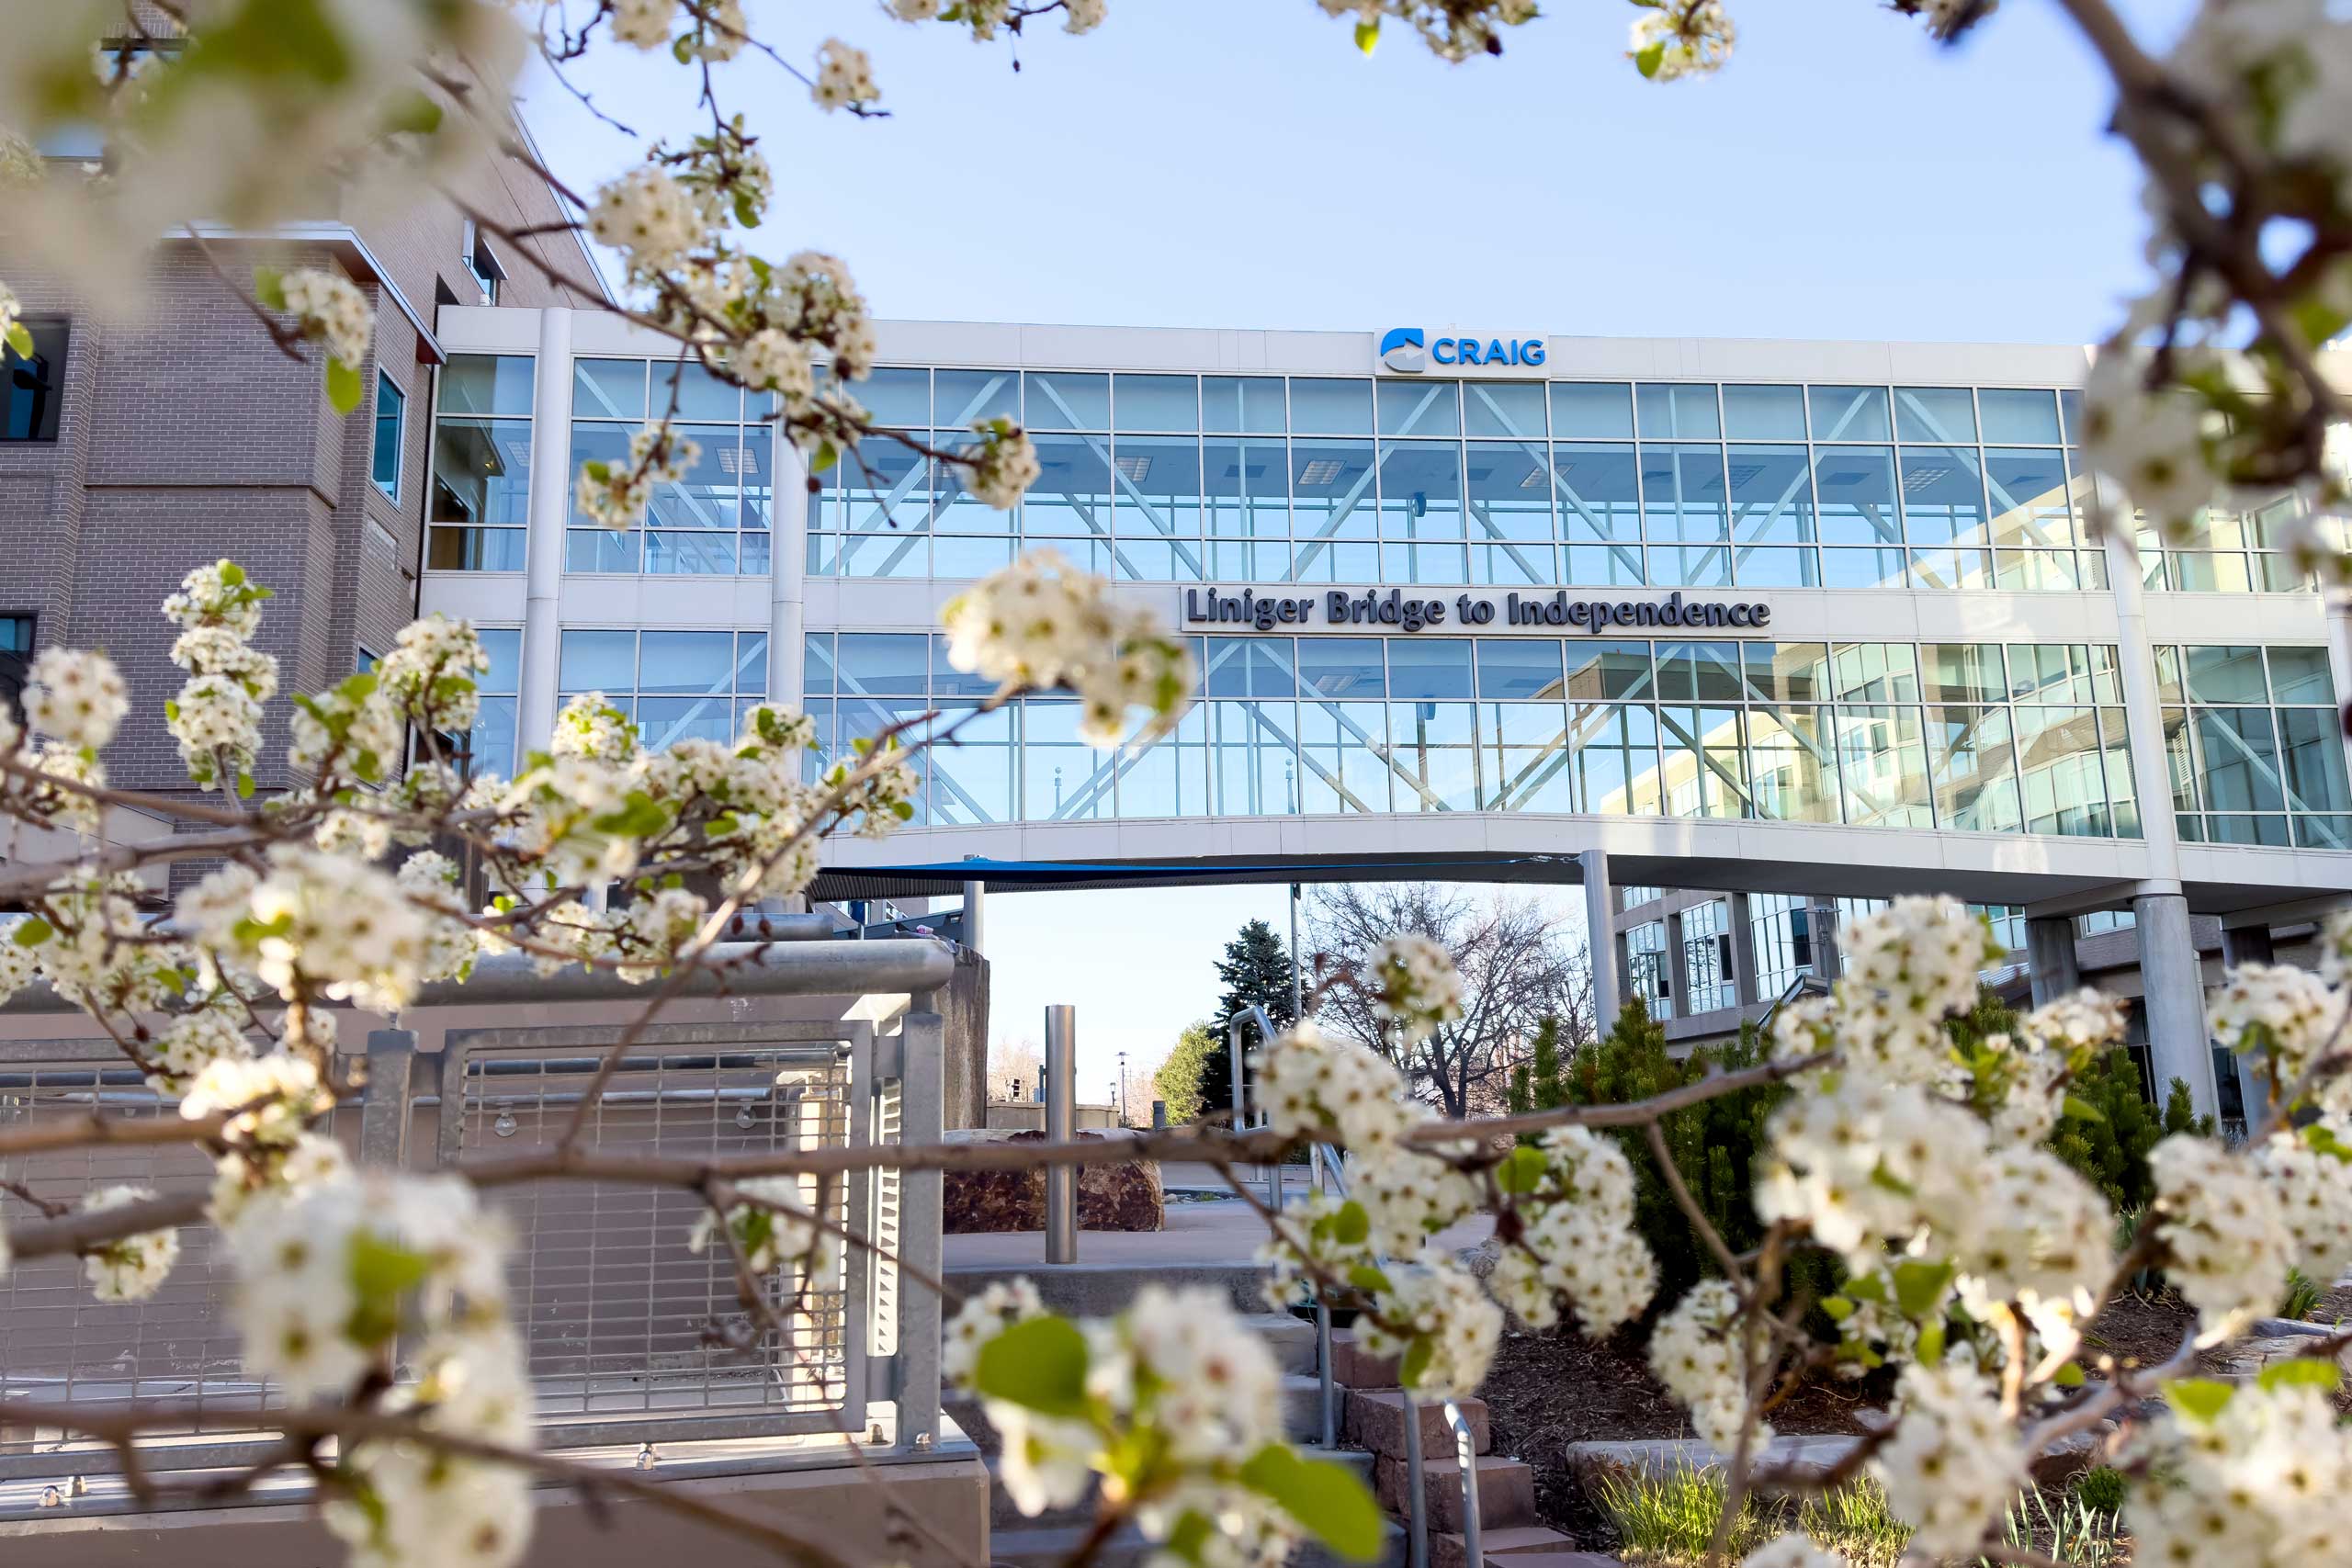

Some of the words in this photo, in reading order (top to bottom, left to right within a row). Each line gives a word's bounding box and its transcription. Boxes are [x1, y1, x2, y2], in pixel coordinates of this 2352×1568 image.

[1431, 337, 1546, 367] CRAIG
[1187, 587, 1315, 631] Liniger
[1327, 589, 1446, 632] Bridge
[1457, 592, 1496, 625] to
[1507, 590, 1771, 634] Independence
